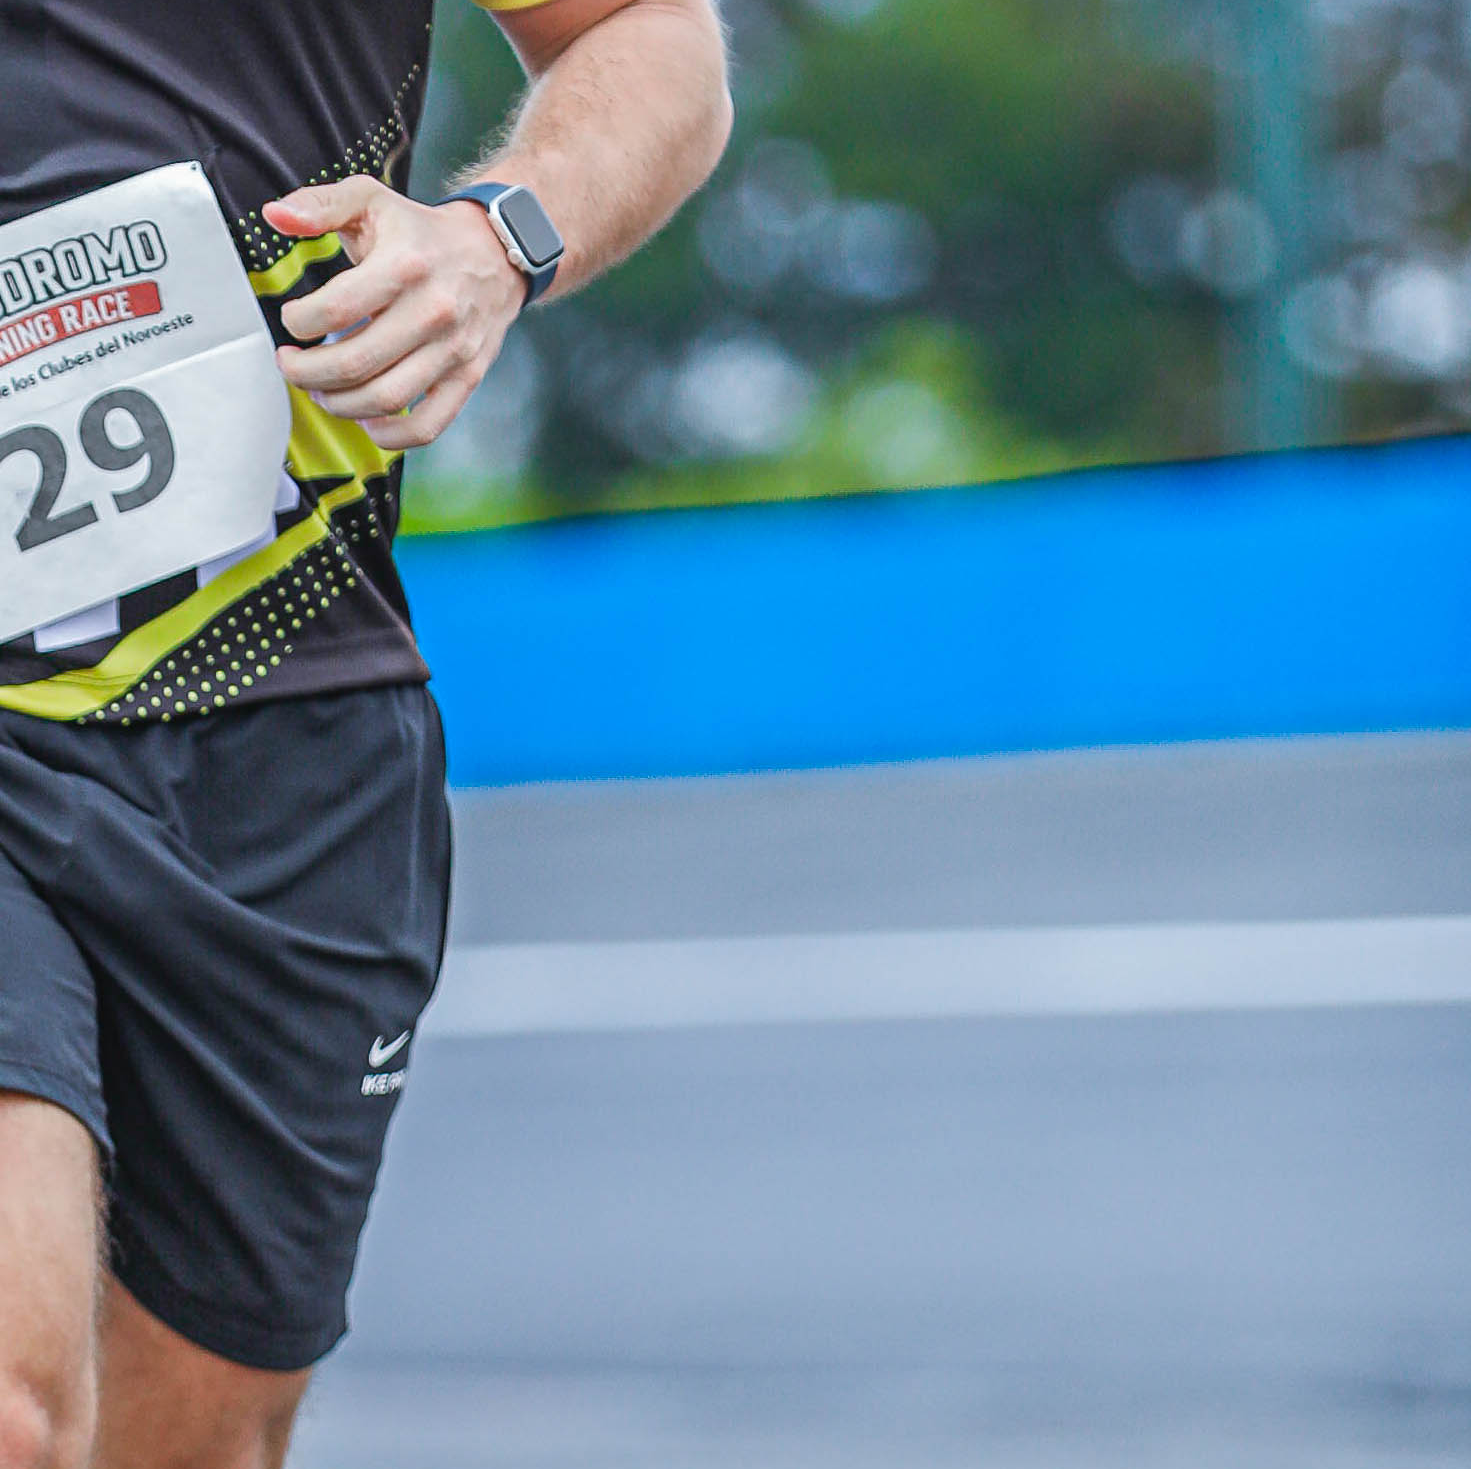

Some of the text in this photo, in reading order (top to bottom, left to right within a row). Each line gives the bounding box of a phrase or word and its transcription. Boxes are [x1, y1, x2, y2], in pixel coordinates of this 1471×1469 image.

[59, 291, 135, 333] RACE
[11, 373, 36, 392] los
[38, 351, 93, 380] Clubes
[95, 335, 120, 358] del
[122, 313, 194, 346] Noroeste
